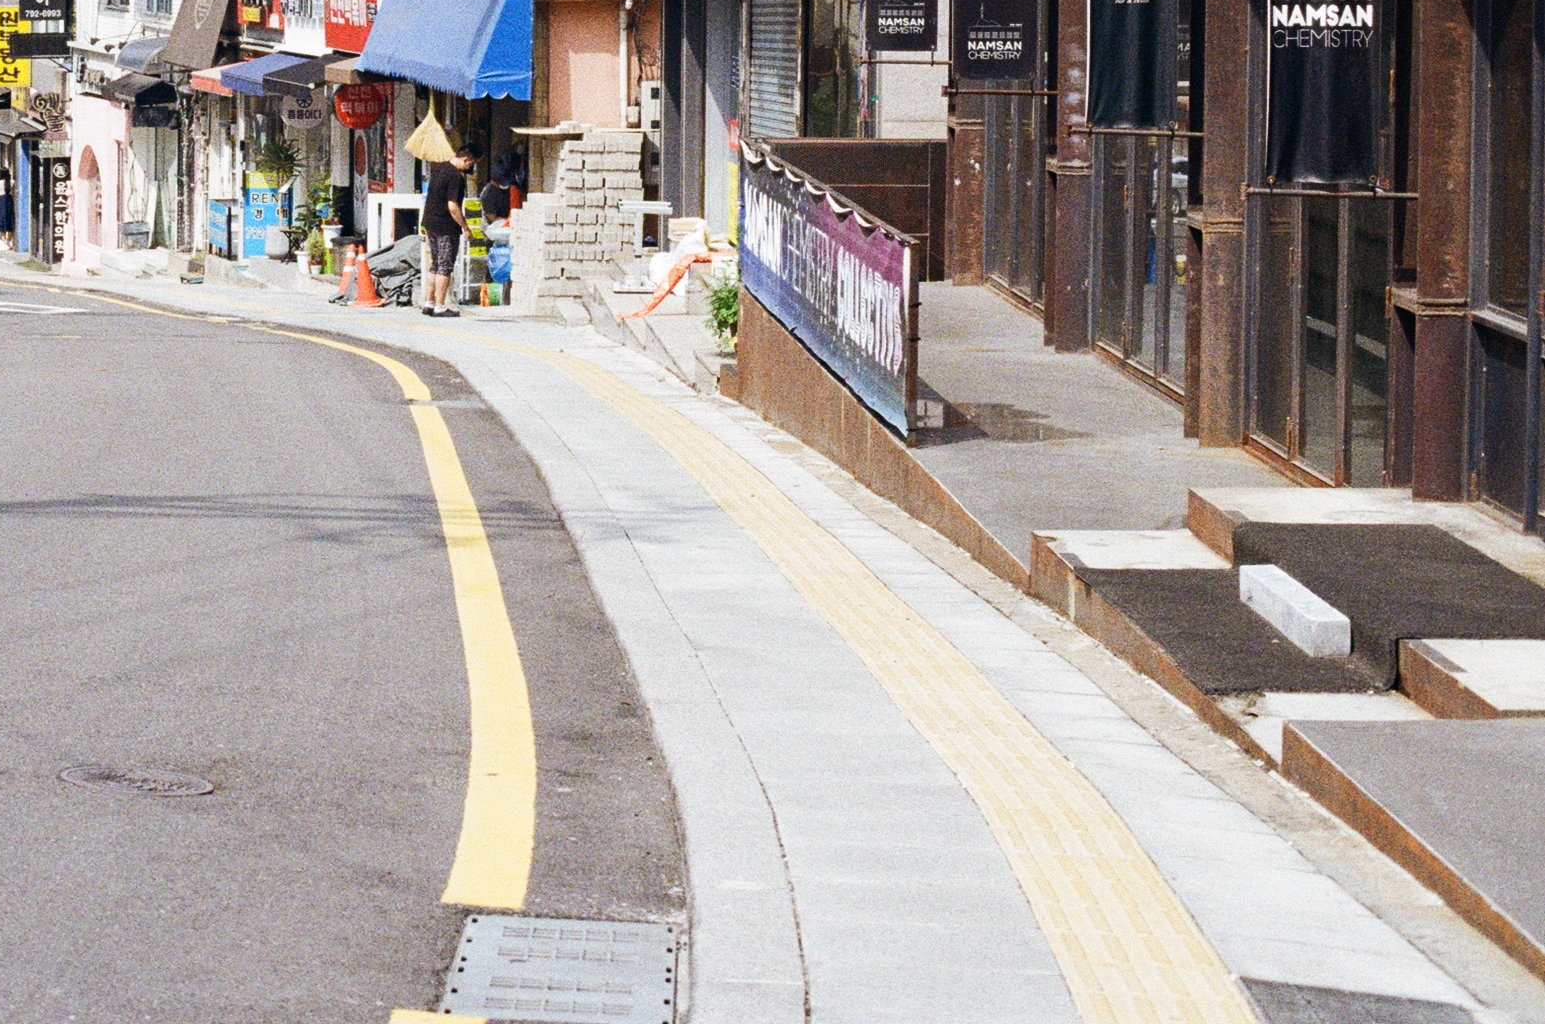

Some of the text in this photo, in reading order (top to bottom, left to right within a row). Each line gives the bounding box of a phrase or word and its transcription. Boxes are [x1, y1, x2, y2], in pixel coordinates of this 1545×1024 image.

[1272, 4, 1373, 27] NAMSAN
[878, 17, 925, 27] NAMSAN
[878, 26, 925, 35] CHEMISTRY
[1273, 29, 1373, 48] CHEMISTRY
[967, 40, 1023, 51] NAMSAN
[967, 50, 1022, 61] CHEMISTRY
